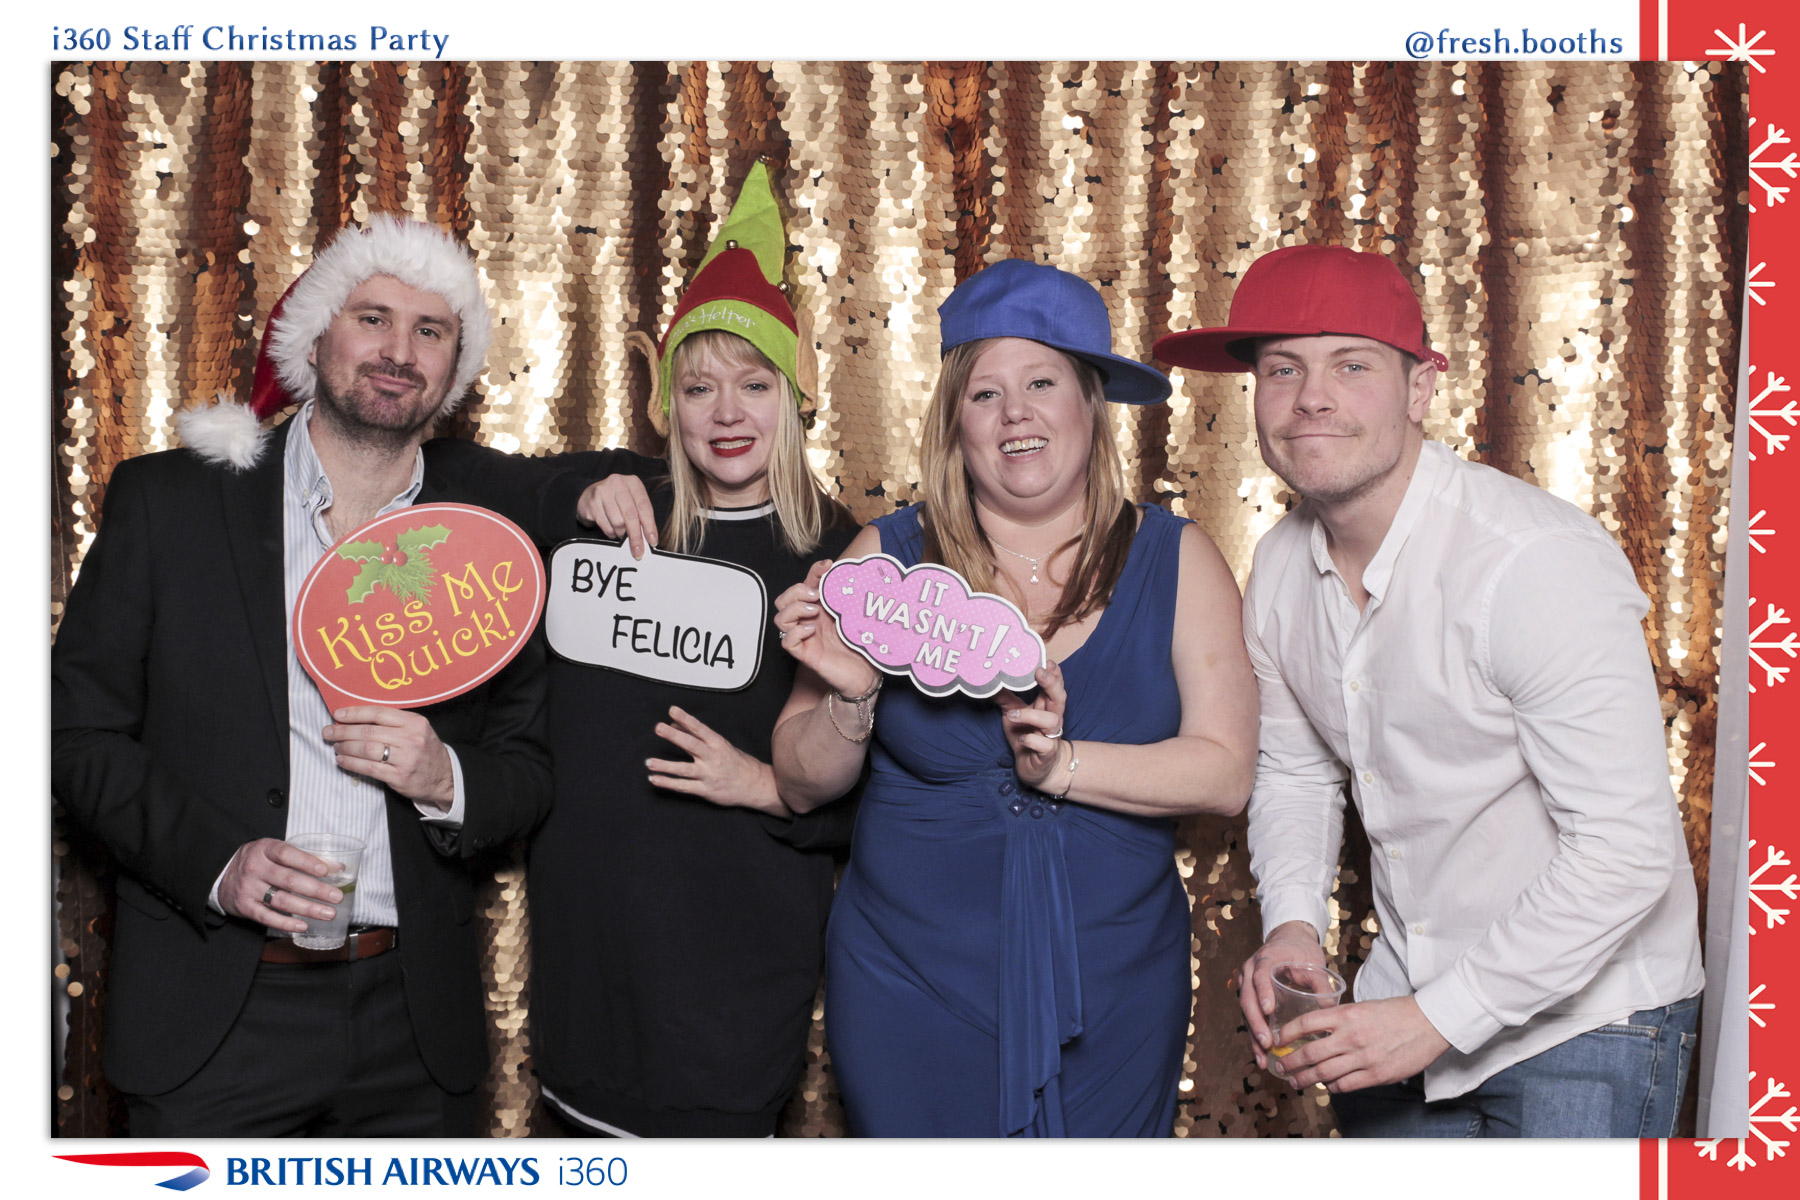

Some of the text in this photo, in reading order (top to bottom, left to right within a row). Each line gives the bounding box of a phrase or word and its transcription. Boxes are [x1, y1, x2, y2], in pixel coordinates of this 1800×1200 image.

[698, 305, 756, 329] Helper
[571, 558, 638, 601] BYE
[919, 578, 949, 607] IT
[317, 561, 524, 670] Kiss Me
[370, 599, 516, 690] Quick!
[612, 613, 735, 669] FELICIA
[915, 641, 962, 674] ME
